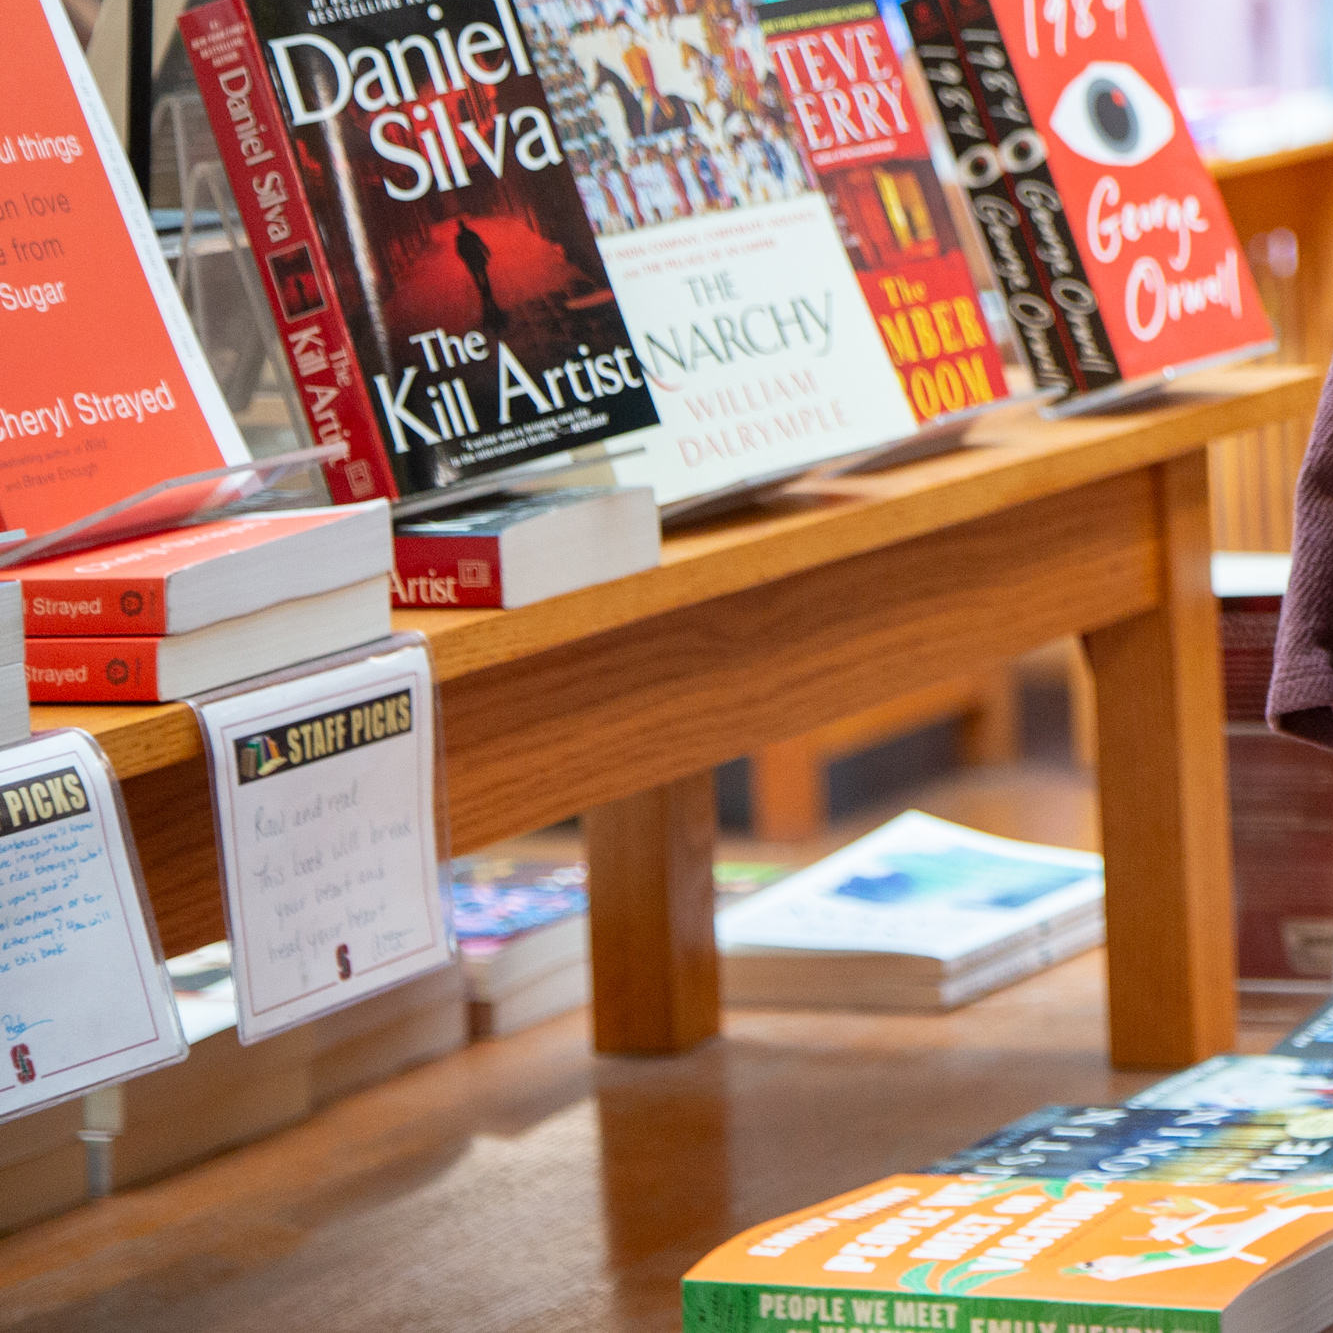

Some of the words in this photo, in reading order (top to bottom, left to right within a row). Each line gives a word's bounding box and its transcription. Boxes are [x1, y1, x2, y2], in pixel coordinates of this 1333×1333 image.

[770, 24, 893, 94] TEVE
[794, 76, 909, 151] ERRY
[18, 133, 83, 164] things
[218, 66, 275, 167] Daniel
[253, 171, 291, 243] Silva
[370, 99, 565, 202] Silva
[23, 192, 71, 217] love
[918, 44, 986, 140] 1984
[974, 194, 1030, 292] George
[1008, 291, 1072, 390] Orwell
[961, 28, 1032, 125] 1984
[1016, 178, 1074, 277] George
[1050, 277, 1115, 375] Orwell
[1087, 174, 1209, 272] George
[12, 237, 65, 264] from
[0, 281, 66, 313] Sugar
[684, 270, 742, 307] THE
[878, 275, 928, 309] The
[1125, 249, 1244, 342] Orwell
[288, 325, 329, 377] Kill
[409, 328, 490, 372] The
[644, 289, 833, 379] NARCHY
[879, 296, 987, 366] MBER
[329, 345, 352, 387] The
[898, 352, 994, 421] OOM
[73, 379, 177, 424] Strayed
[374, 366, 480, 454] Kill
[498, 341, 644, 425] Artist
[684, 369, 818, 423] WILLIAM
[677, 398, 853, 469] DALRYMPLE
[23, 470, 55, 489] Brave
[58, 463, 99, 481] Enough
[33, 597, 102, 618] Strayed
[286, 714, 348, 765] STAFF
[351, 693, 412, 746] PICKS
[2, 773, 87, 828] PICKS
[1225, 1140, 1332, 1180] THE
[822, 1208, 956, 1273] PEOPLE
[907, 1213, 1014, 1261] MEET
[967, 1190, 1124, 1272] VACATION
[759, 1293, 845, 1324] PEOPLE
[852, 1298, 888, 1326] WE
[894, 1301, 959, 1330] MEET
